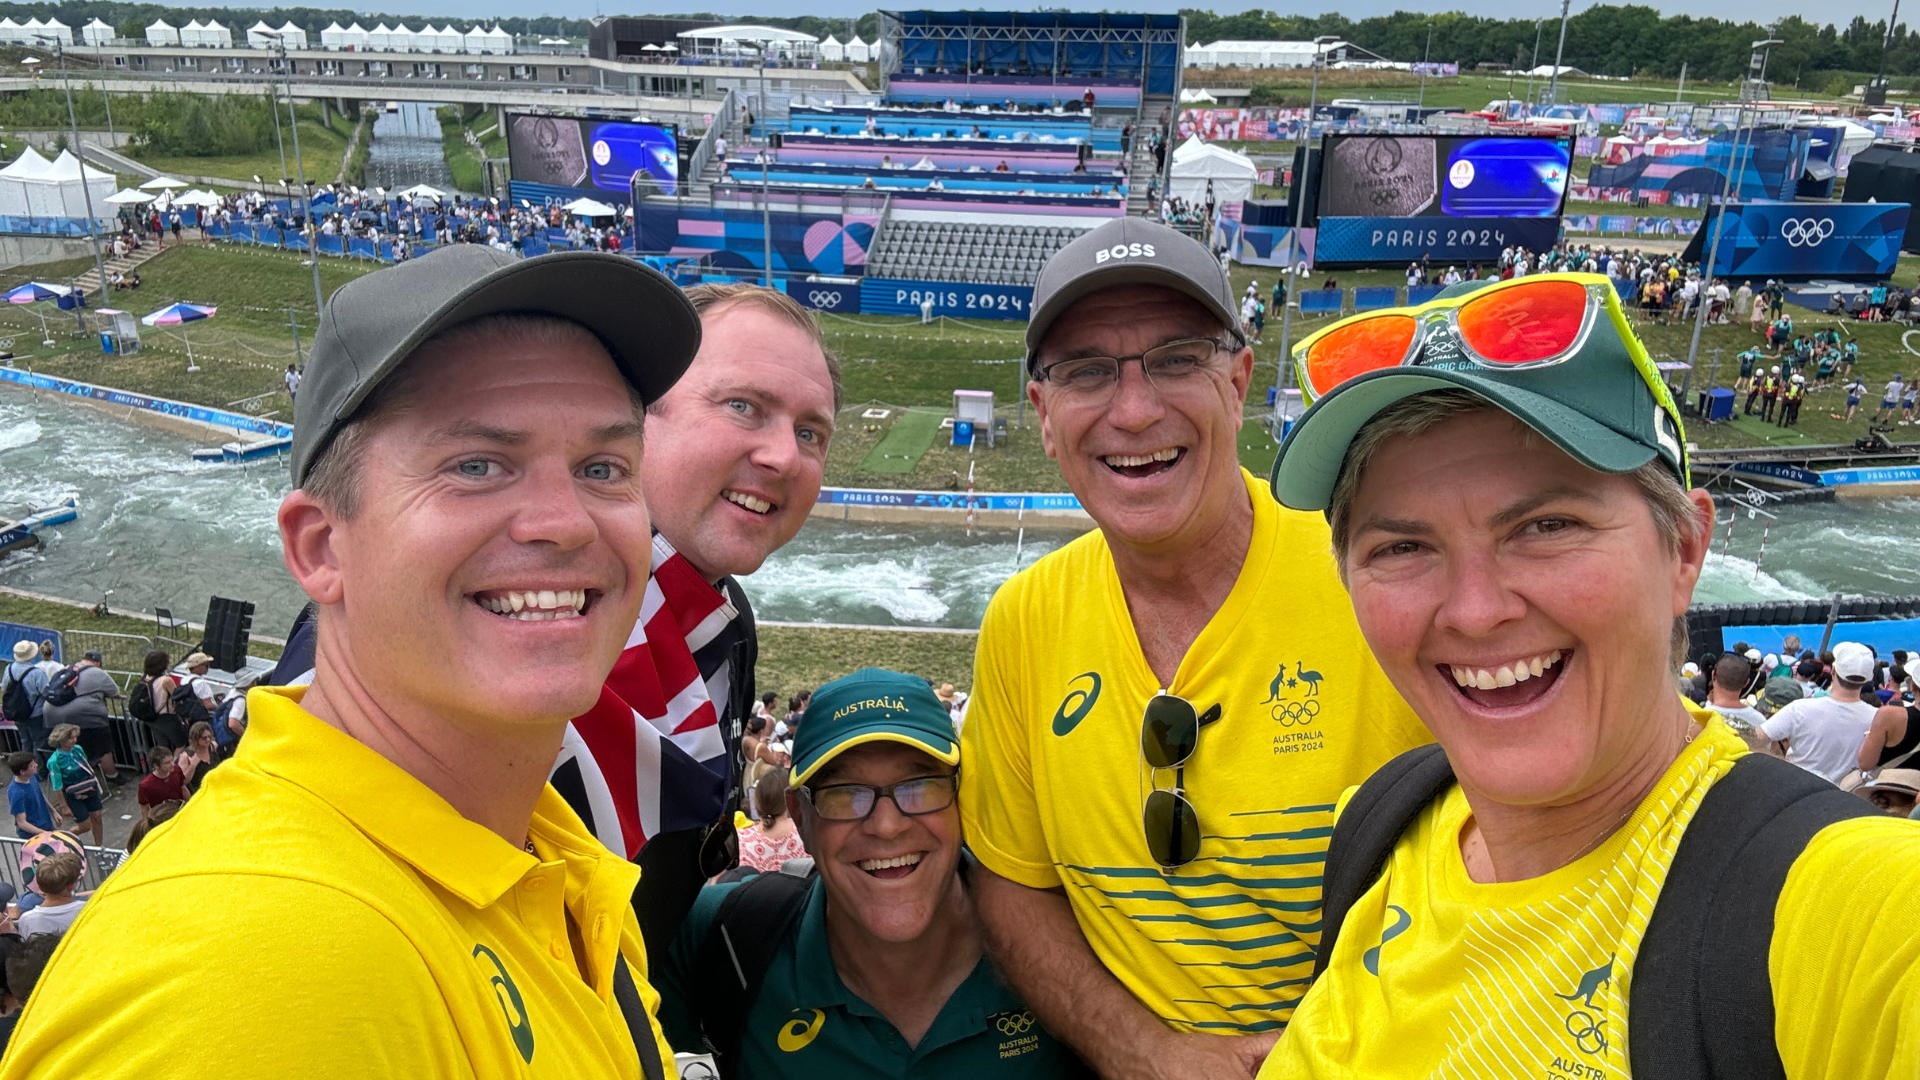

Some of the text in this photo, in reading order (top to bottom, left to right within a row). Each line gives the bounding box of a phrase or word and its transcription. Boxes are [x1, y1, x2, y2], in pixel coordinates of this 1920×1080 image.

[1371, 230, 1505, 247] PARIS 2024
[1095, 243, 1156, 264] BOSS
[896, 289, 1022, 311] PARIS 2024
[1420, 353, 1459, 365] AUSTRALIA
[1775, 467, 1803, 480] 2024
[1867, 470, 1917, 480] PARIS 2024
[843, 493, 902, 503] PARIS 2024
[1043, 498, 1073, 506] PARIS
[832, 699, 905, 721] AUSTRALIA
[1273, 730, 1324, 744] AUSTRALIA
[1274, 742, 1324, 755] PARIS 2024
[999, 1035, 1038, 1050] AUSTRALIA
[1000, 1043, 1038, 1059] PARIS 2024
